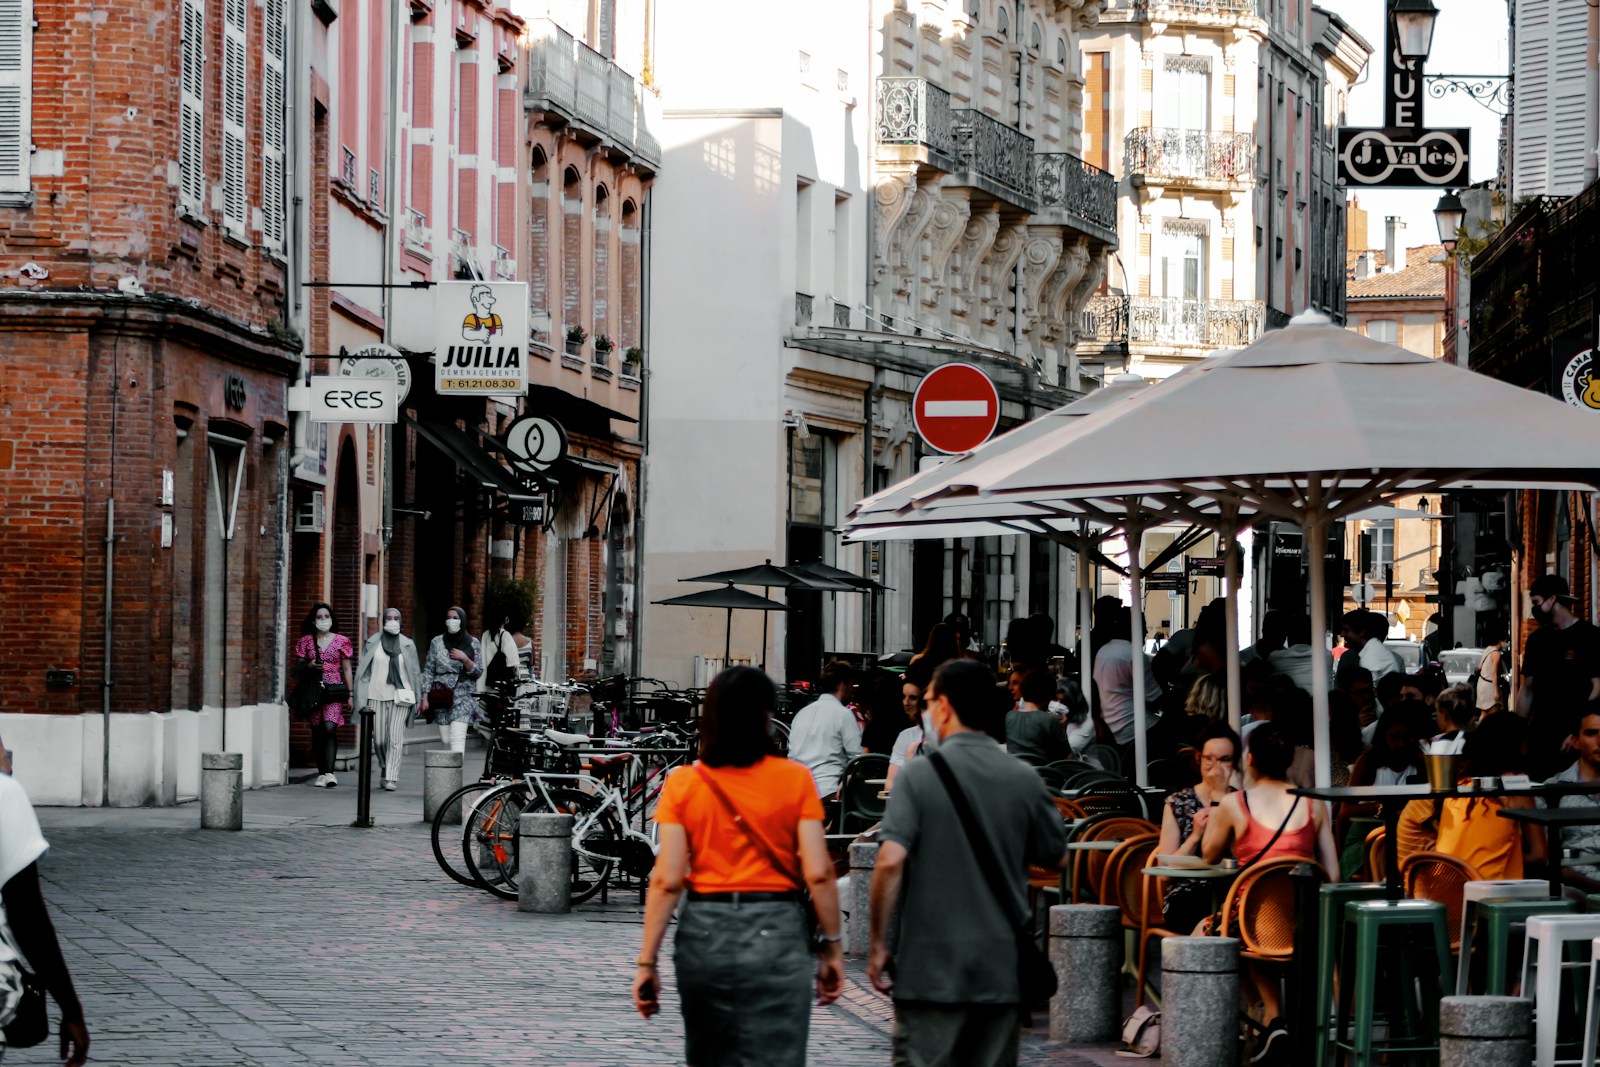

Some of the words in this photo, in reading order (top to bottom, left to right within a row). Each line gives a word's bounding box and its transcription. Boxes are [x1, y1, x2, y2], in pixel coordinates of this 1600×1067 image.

[442, 346, 519, 368] JUILIA
[440, 369, 521, 377] DEMENAGEMENTS
[446, 380, 456, 388] T:
[458, 380, 516, 388] 61.21.08.30
[324, 390, 383, 409] ERES
